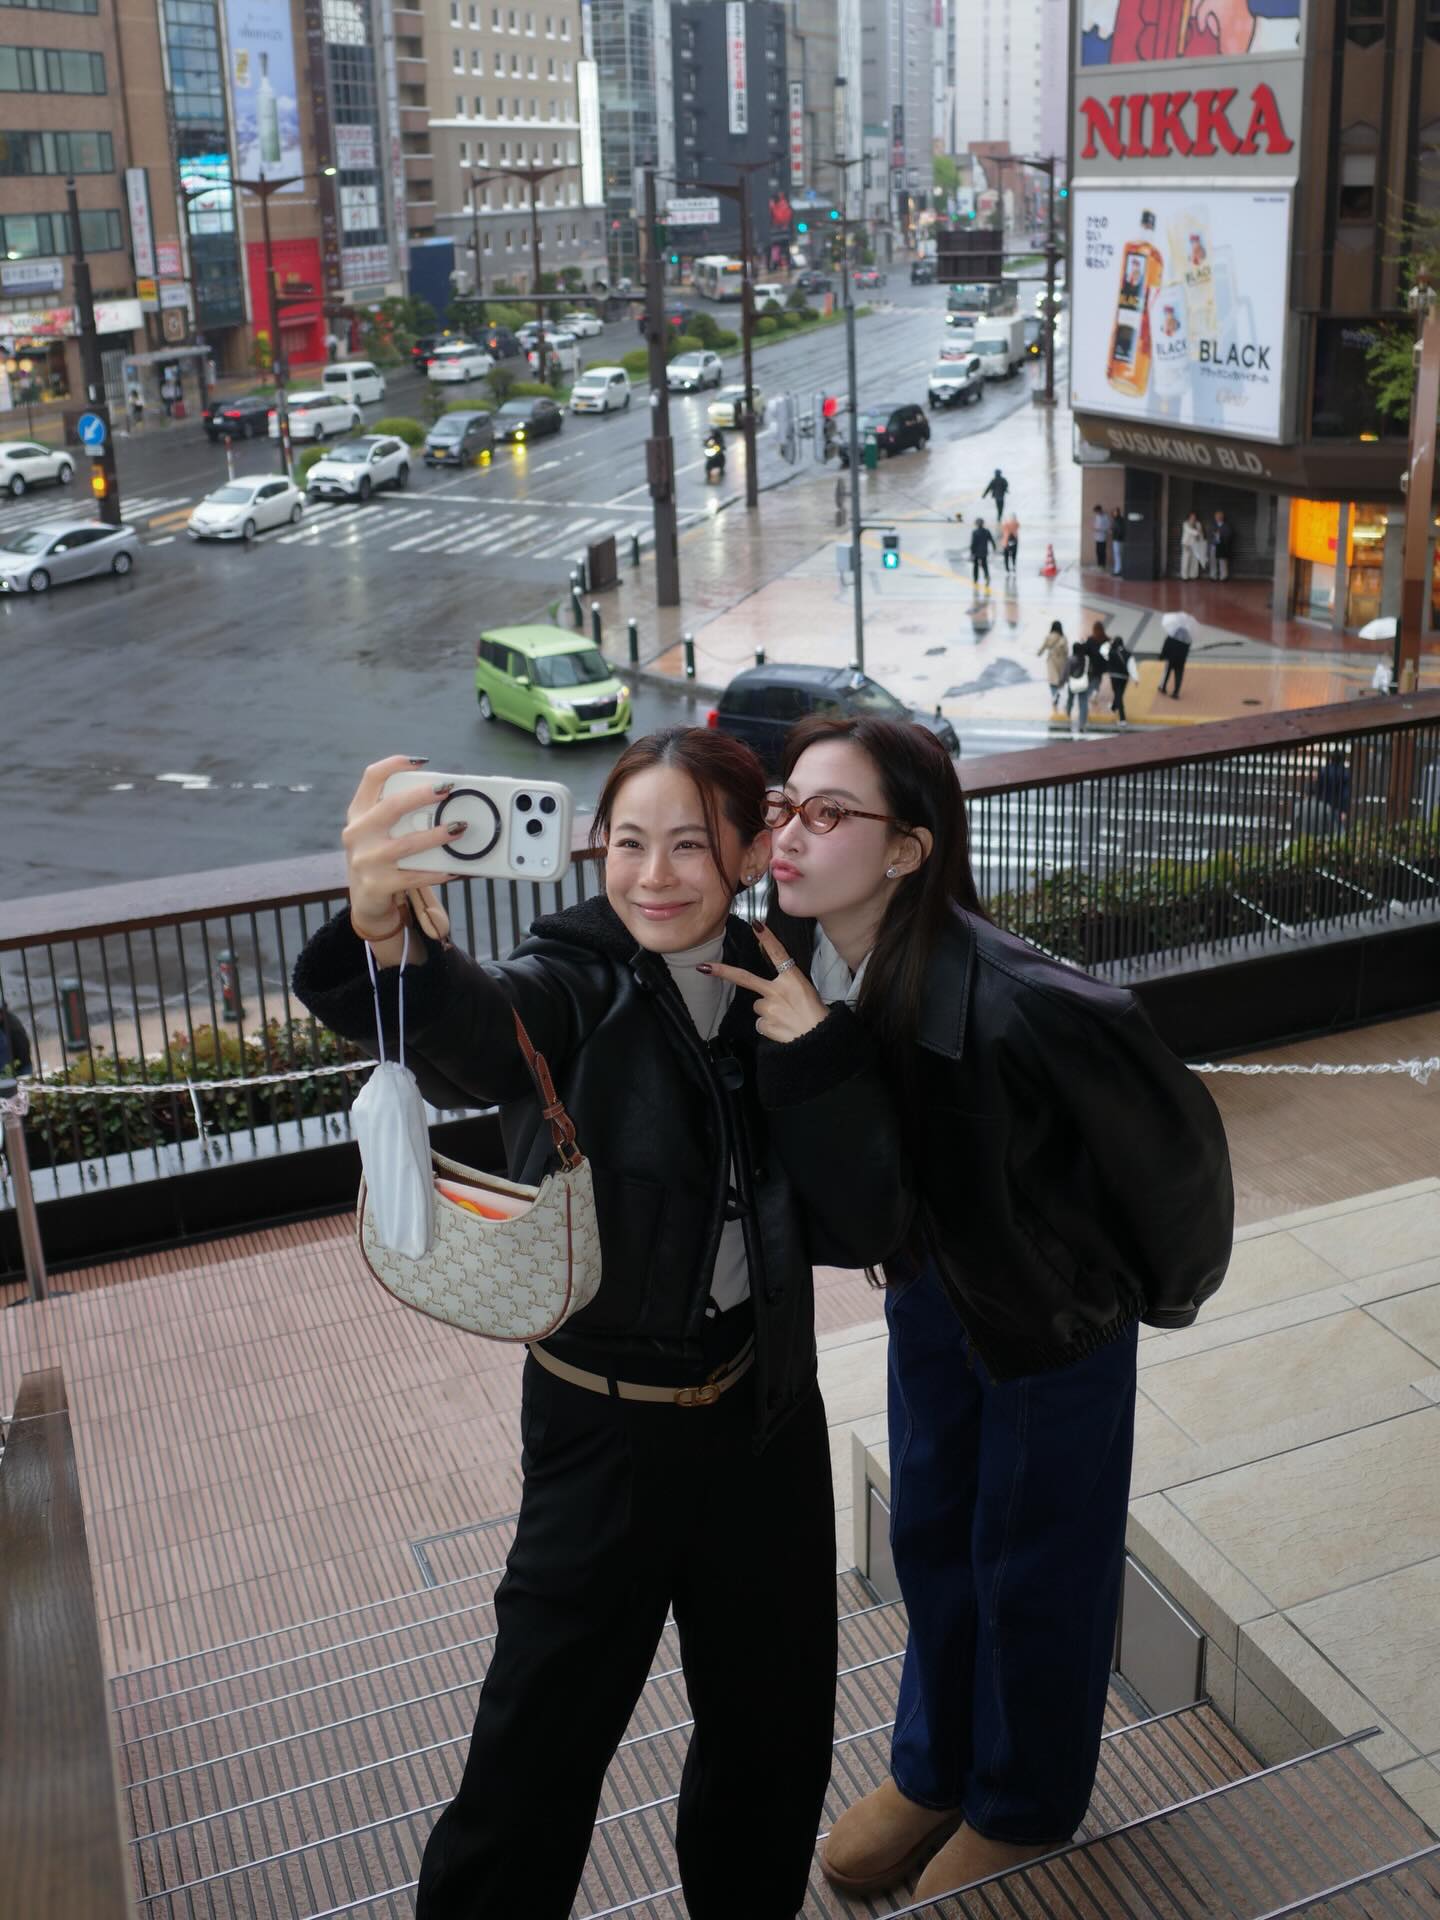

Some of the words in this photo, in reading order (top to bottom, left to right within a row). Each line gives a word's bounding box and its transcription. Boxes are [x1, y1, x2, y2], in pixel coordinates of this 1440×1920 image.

[1079, 82, 1294, 161] NIKKA
[1200, 338, 1270, 370] BLACK
[1107, 428, 1211, 465] SUSUKINO
[1217, 447, 1272, 477] BLD.
